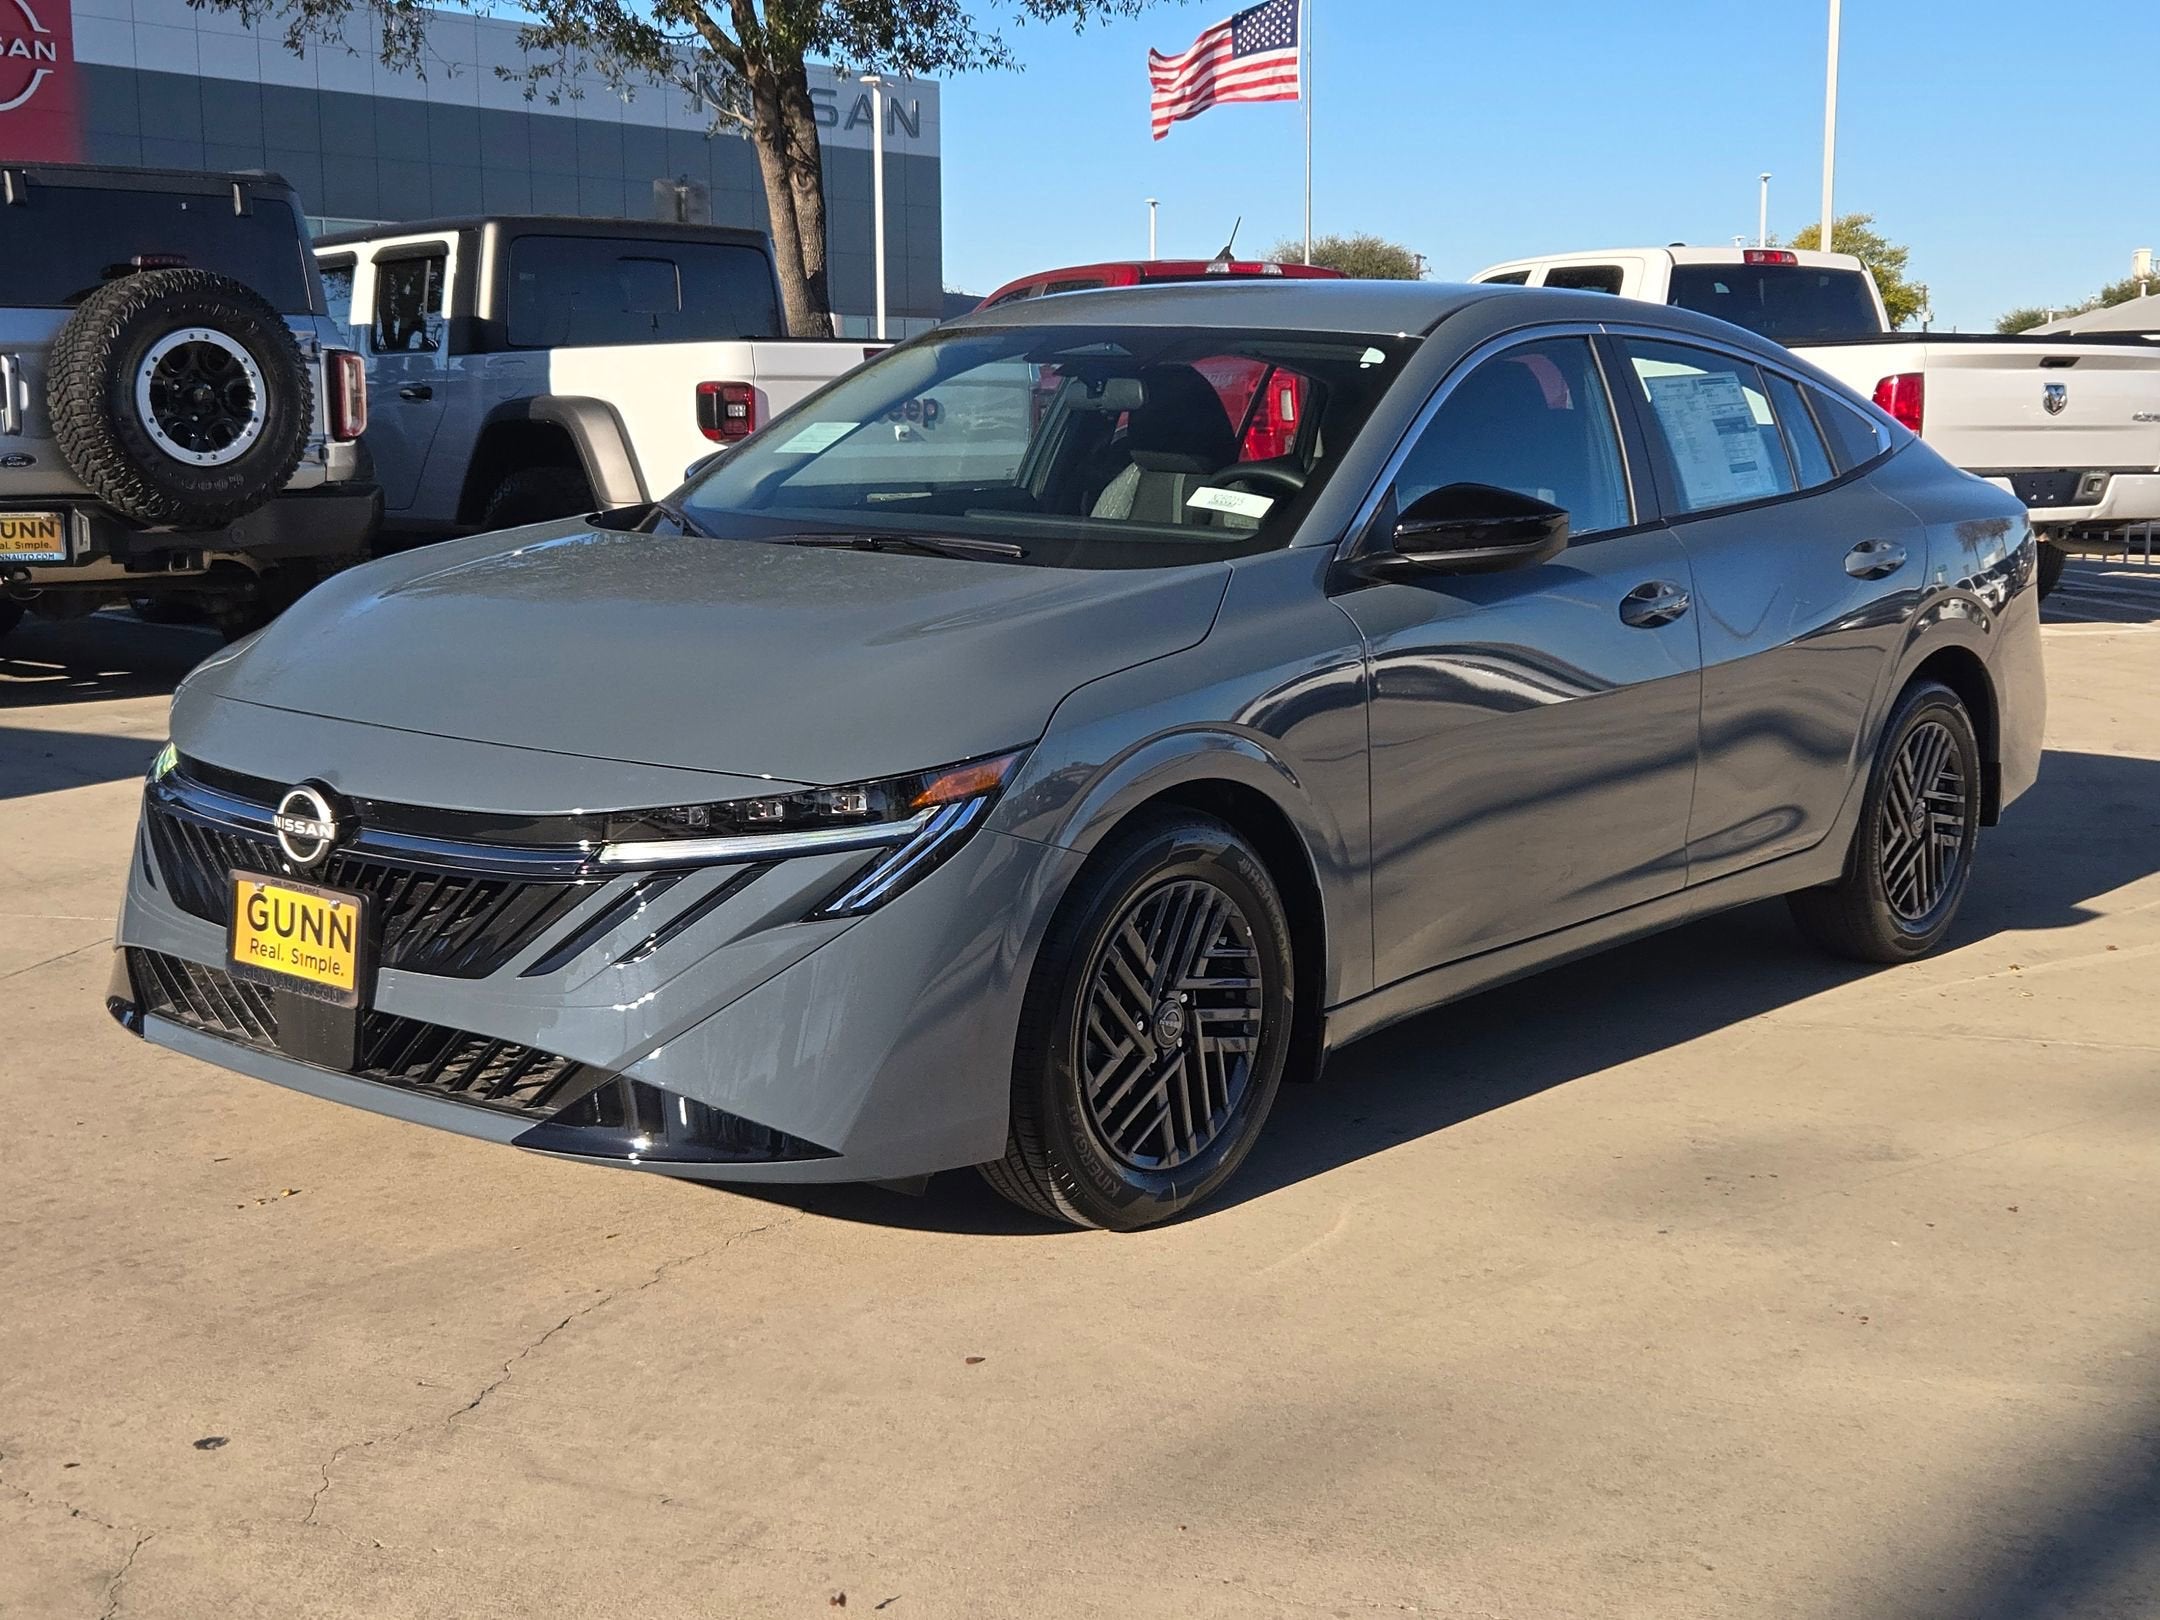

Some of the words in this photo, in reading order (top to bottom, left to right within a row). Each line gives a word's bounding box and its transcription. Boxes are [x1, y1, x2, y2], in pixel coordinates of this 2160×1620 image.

[0, 38, 56, 62] AN
[694, 71, 920, 139] NSAN
[0, 521, 55, 539] UNN
[274, 814, 335, 840] NISSAN
[247, 893, 352, 954] GUNN
[250, 938, 285, 962] Real.
[291, 947, 344, 977] Simple.
